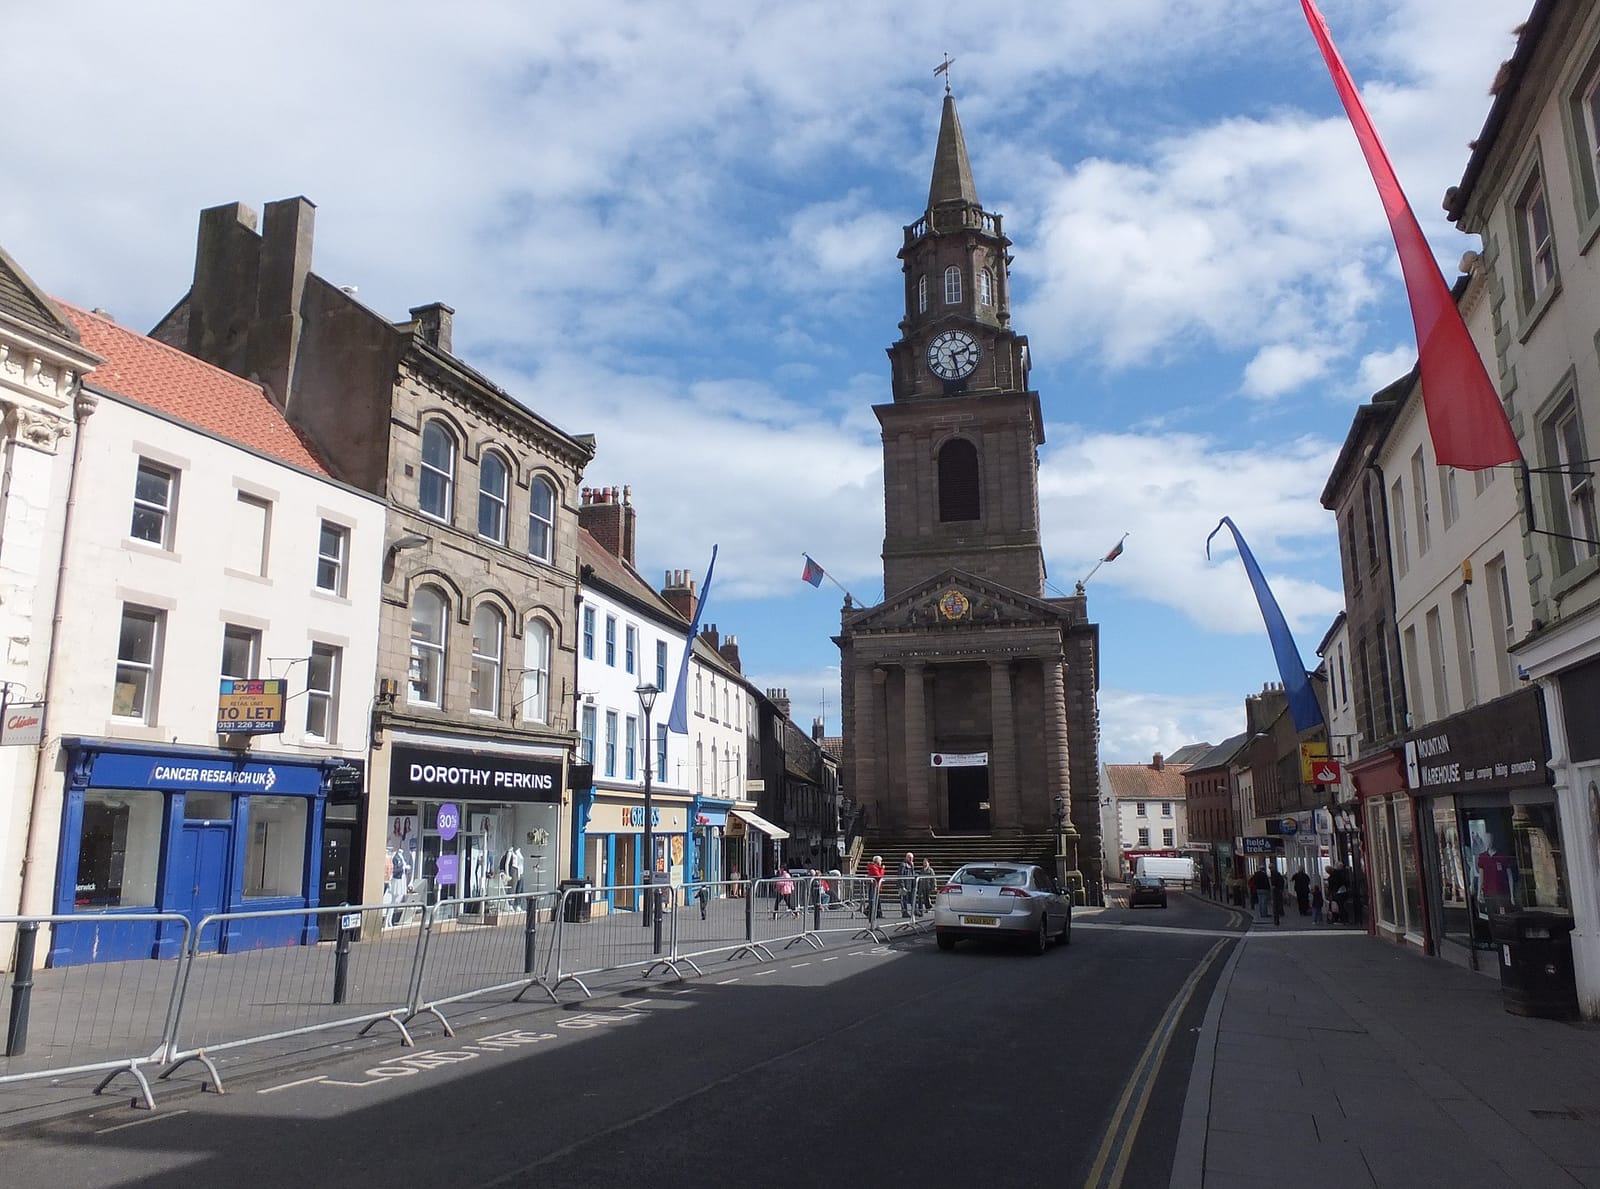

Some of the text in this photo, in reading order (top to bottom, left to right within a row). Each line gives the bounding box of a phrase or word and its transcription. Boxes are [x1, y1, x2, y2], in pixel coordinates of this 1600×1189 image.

[219, 707, 275, 720] TO LET
[154, 766, 267, 785] CANCER RESEARCH UK
[409, 763, 553, 789] DOROTHY PERKINS
[318, 1031, 558, 1087] LOADING
